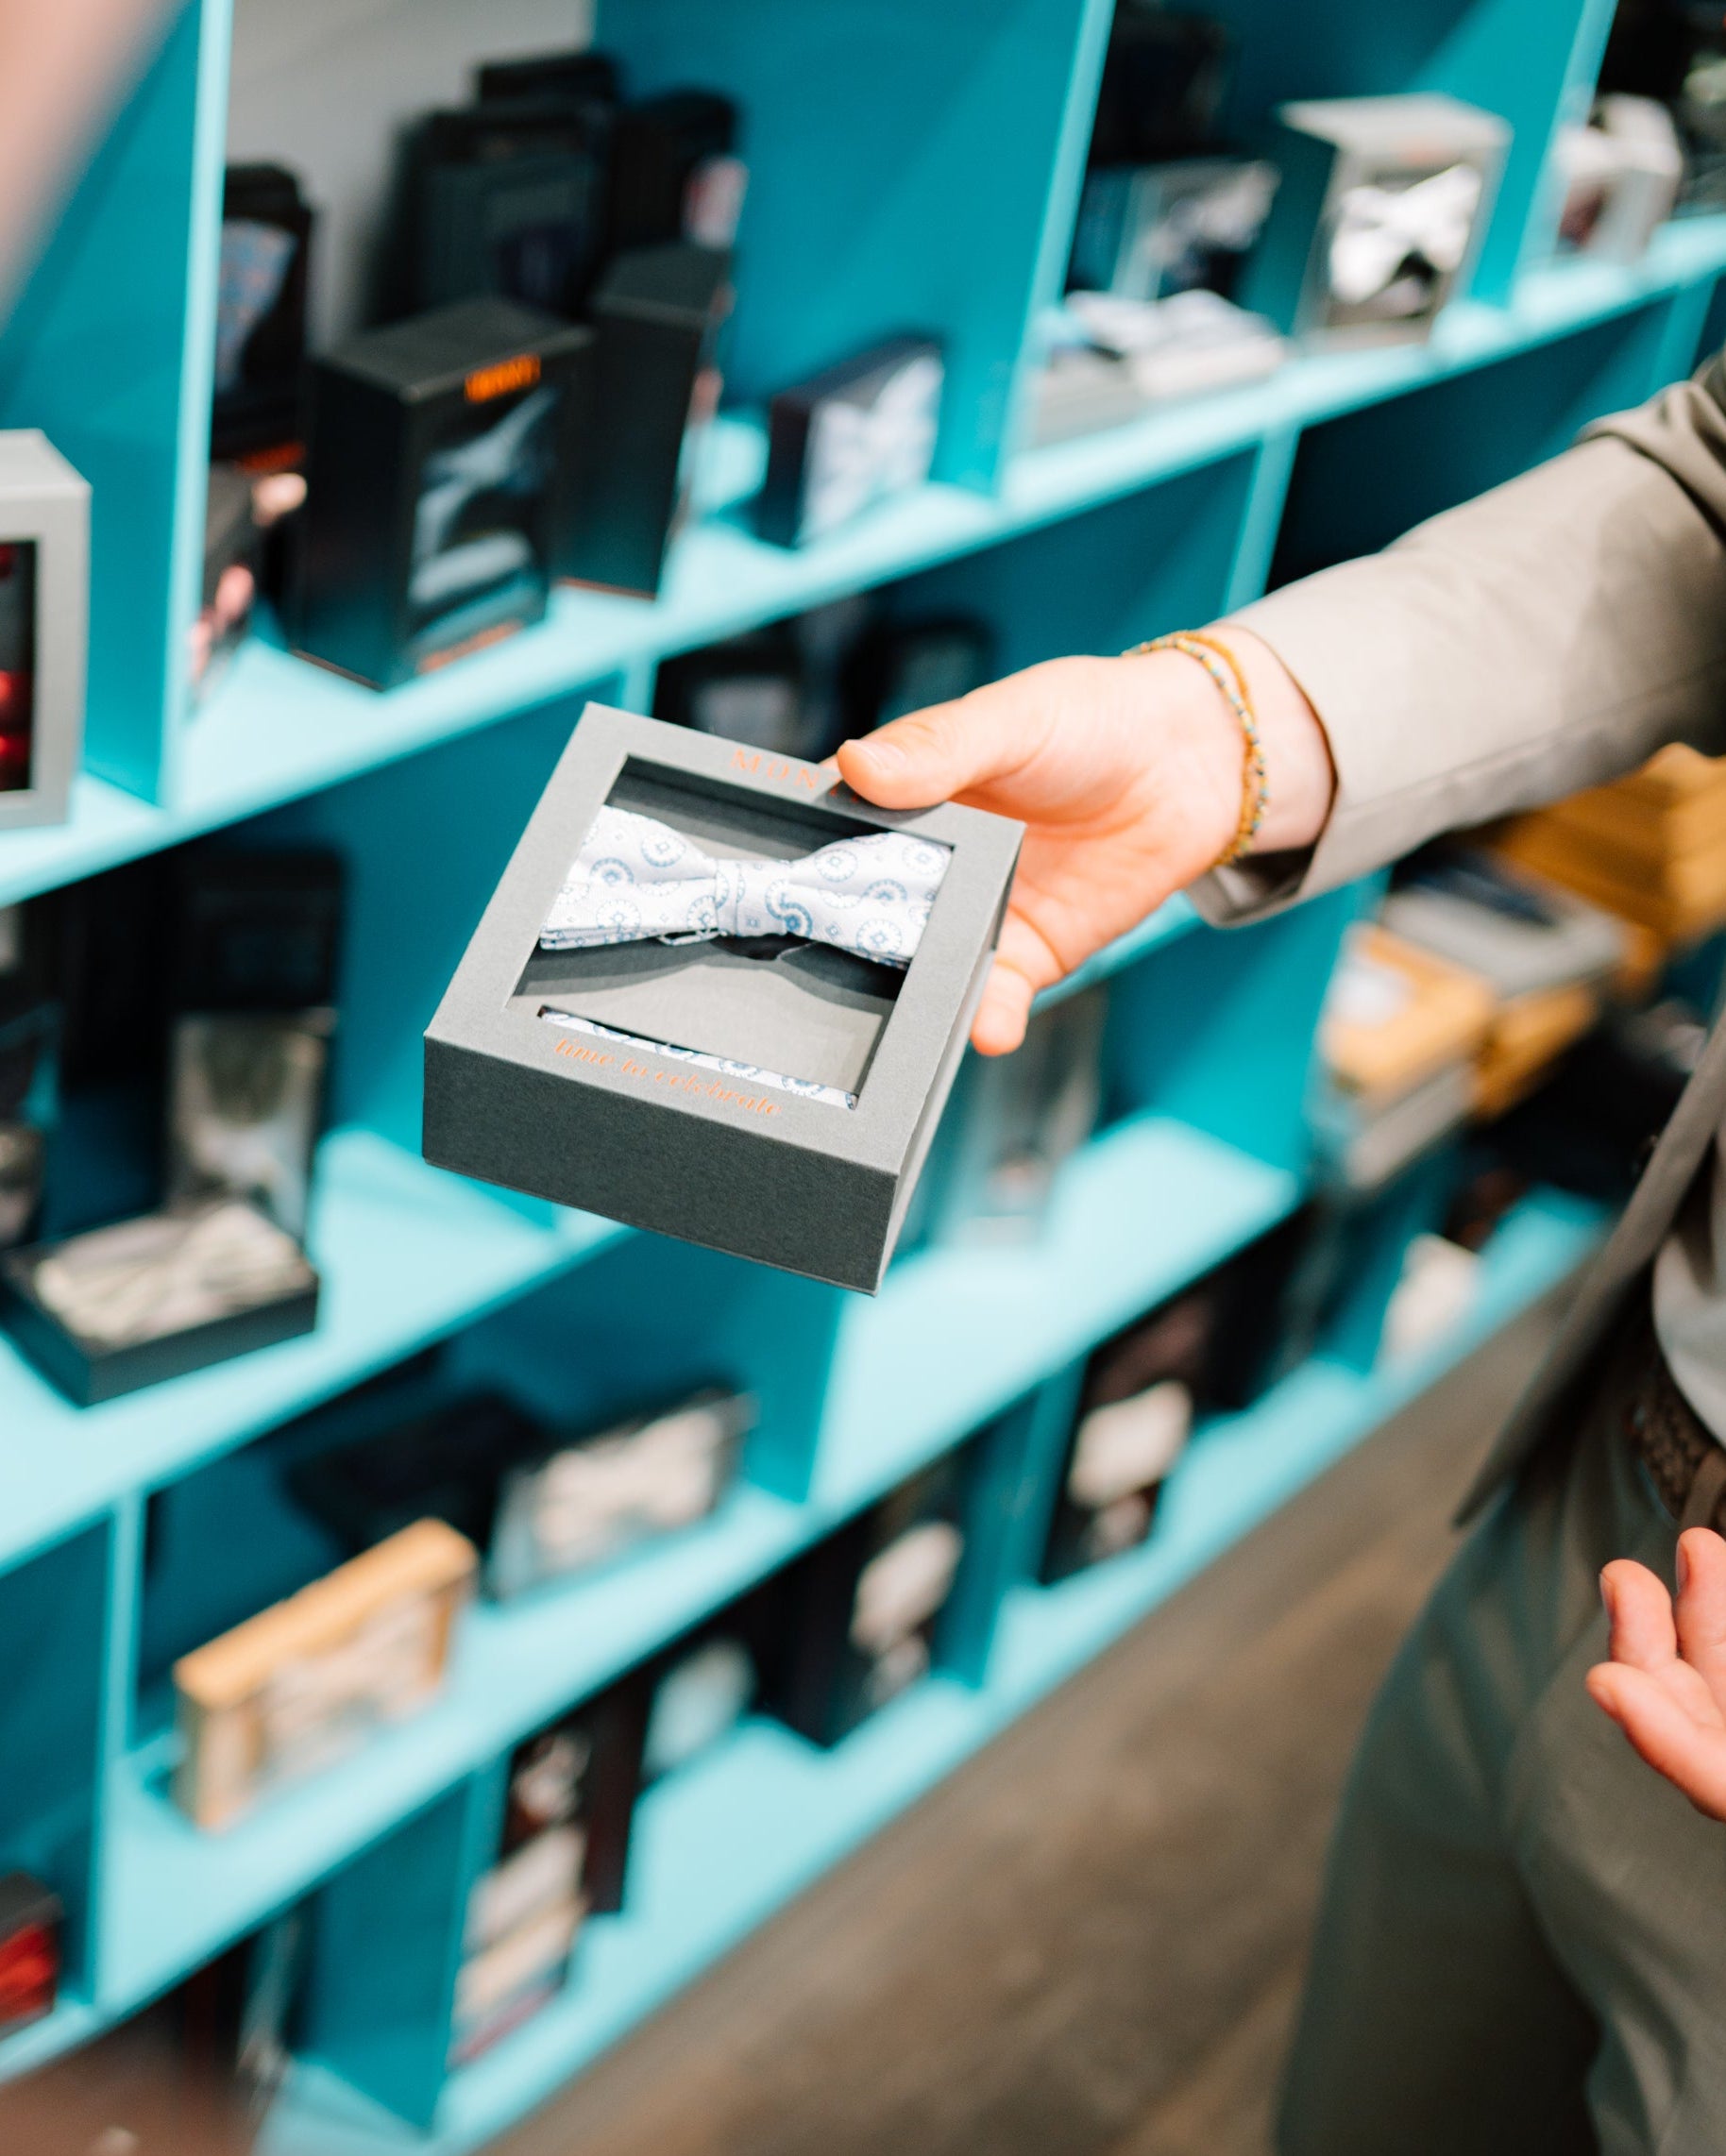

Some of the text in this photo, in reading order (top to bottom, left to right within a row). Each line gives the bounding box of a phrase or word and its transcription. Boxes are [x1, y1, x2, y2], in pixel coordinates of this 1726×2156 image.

[554, 1038, 782, 1115] time to celebrate
